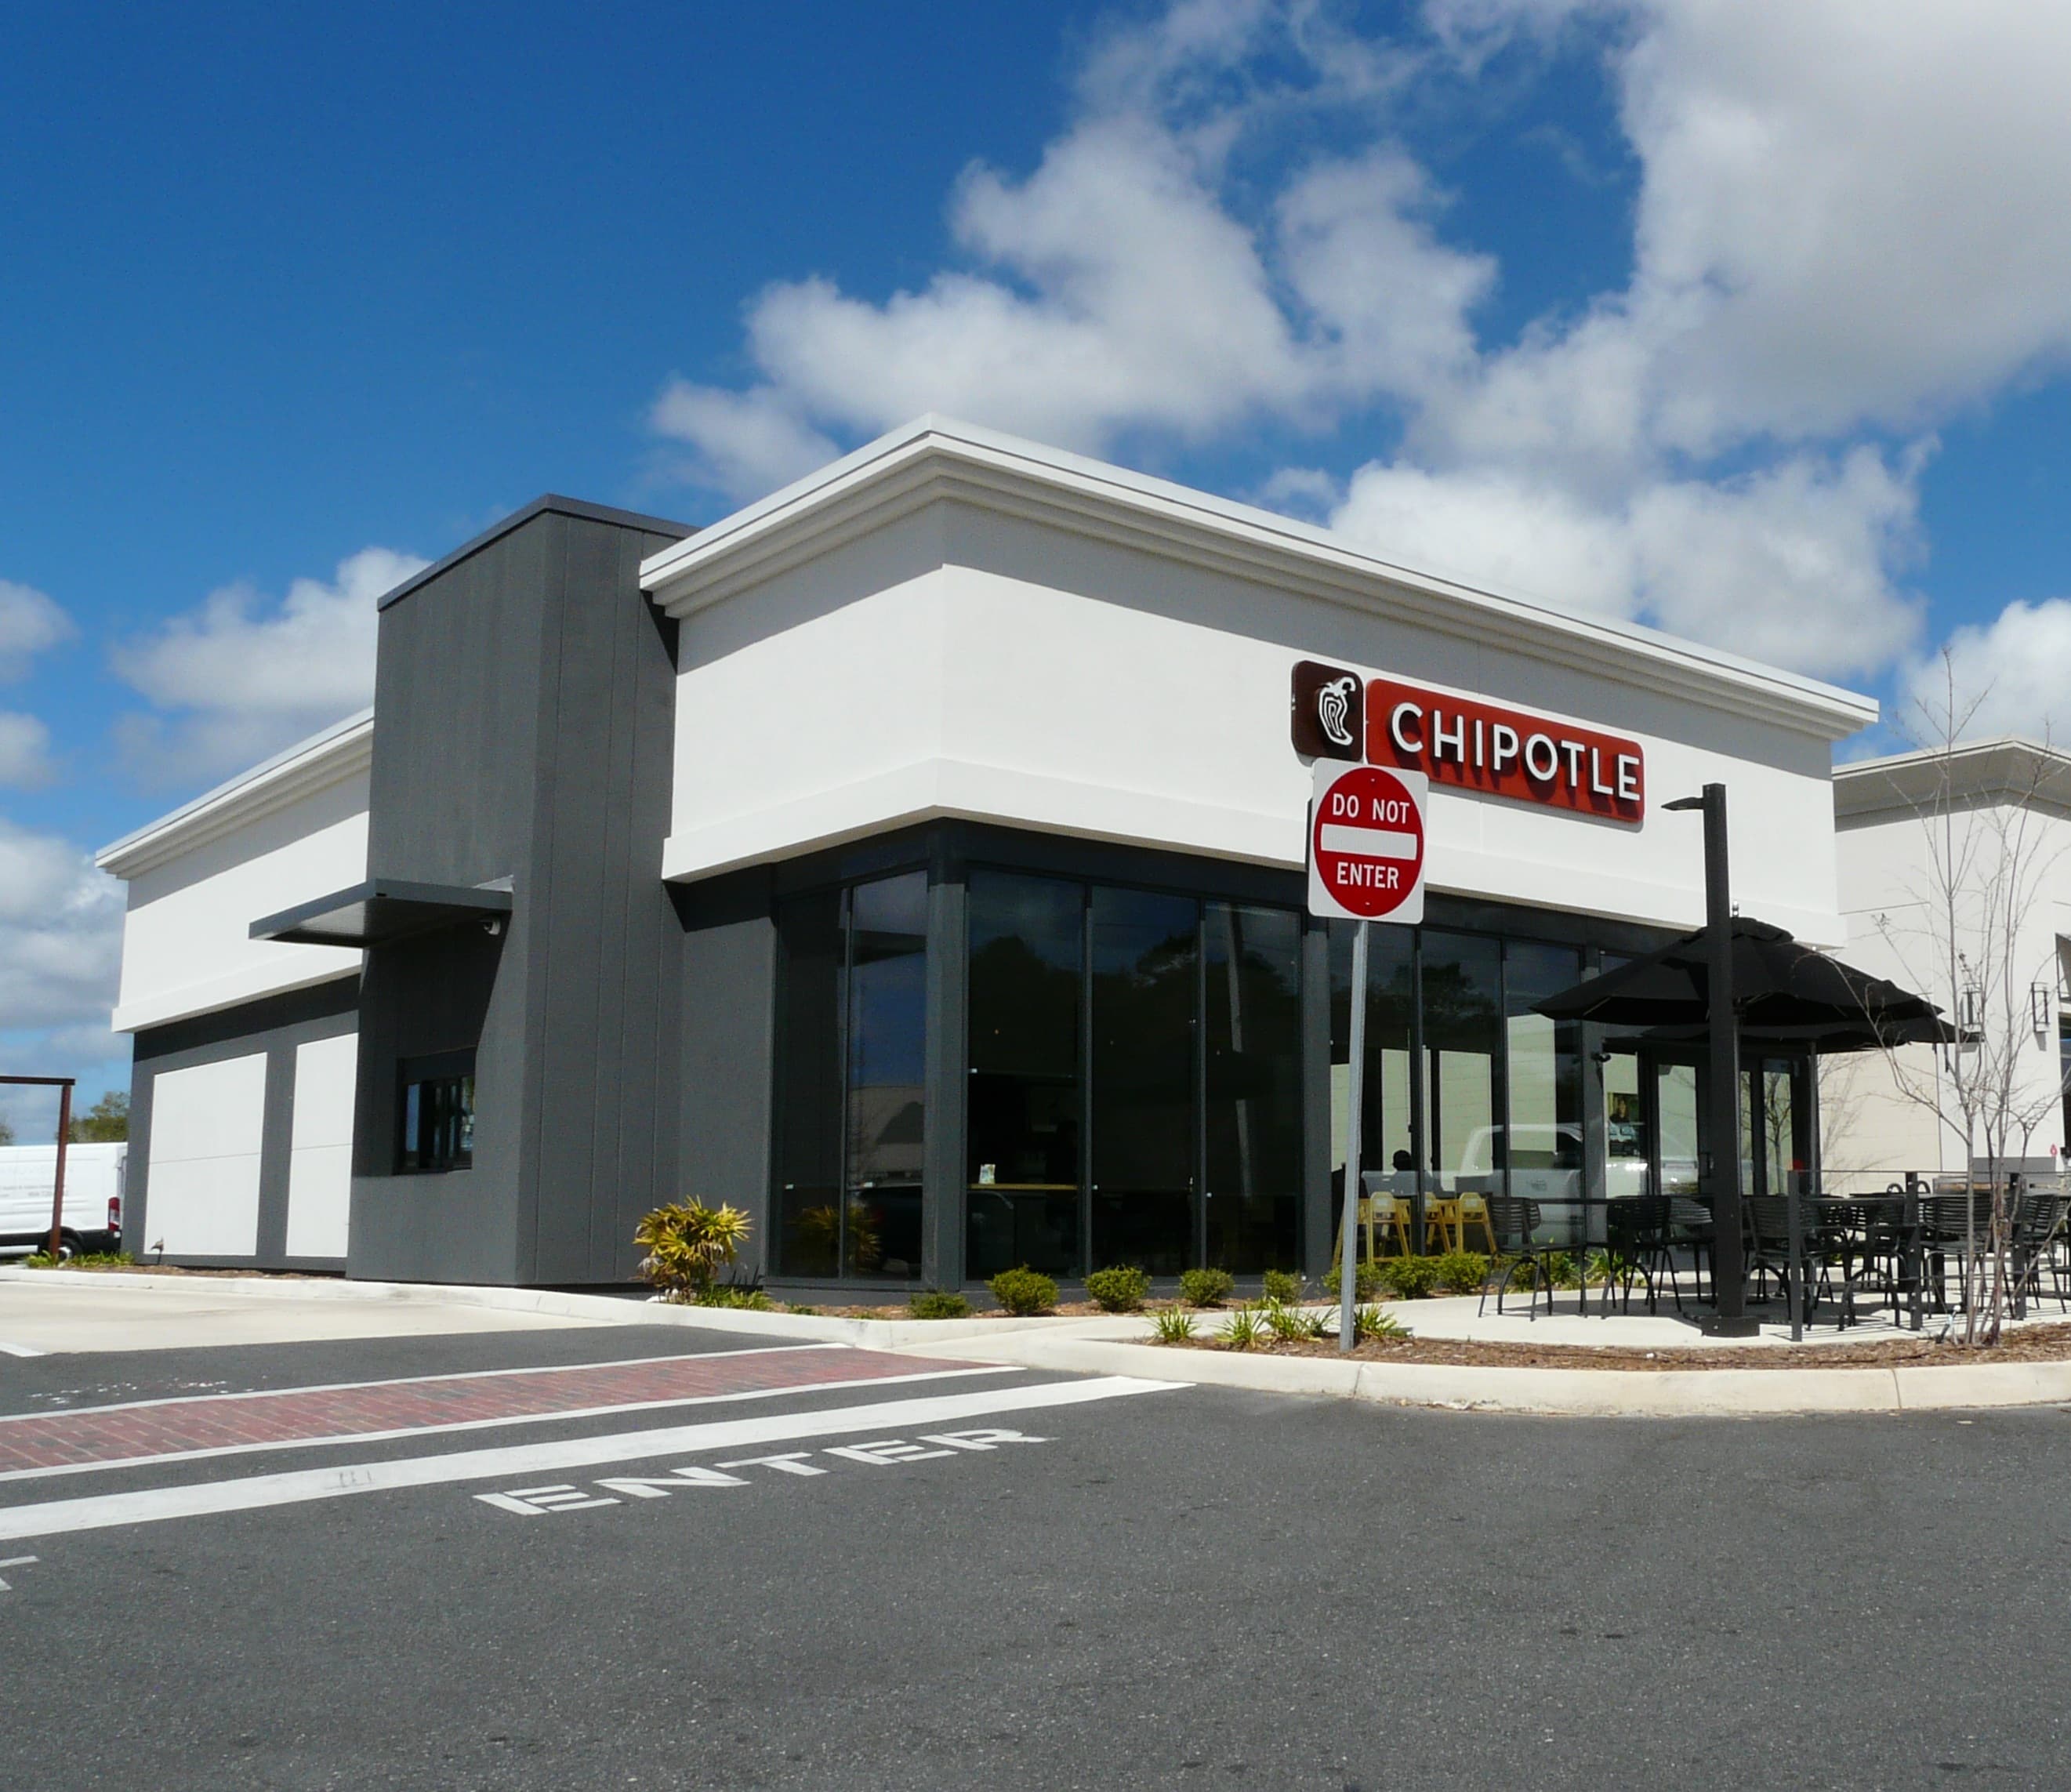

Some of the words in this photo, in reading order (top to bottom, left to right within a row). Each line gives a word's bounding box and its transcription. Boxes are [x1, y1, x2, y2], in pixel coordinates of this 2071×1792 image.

[1391, 702, 1641, 801] CHIPOTLE
[1332, 793, 1360, 818] DO
[1372, 800, 1410, 825] NOT
[1336, 862, 1399, 891] ENTER
[472, 1427, 1050, 1517] ENTER
